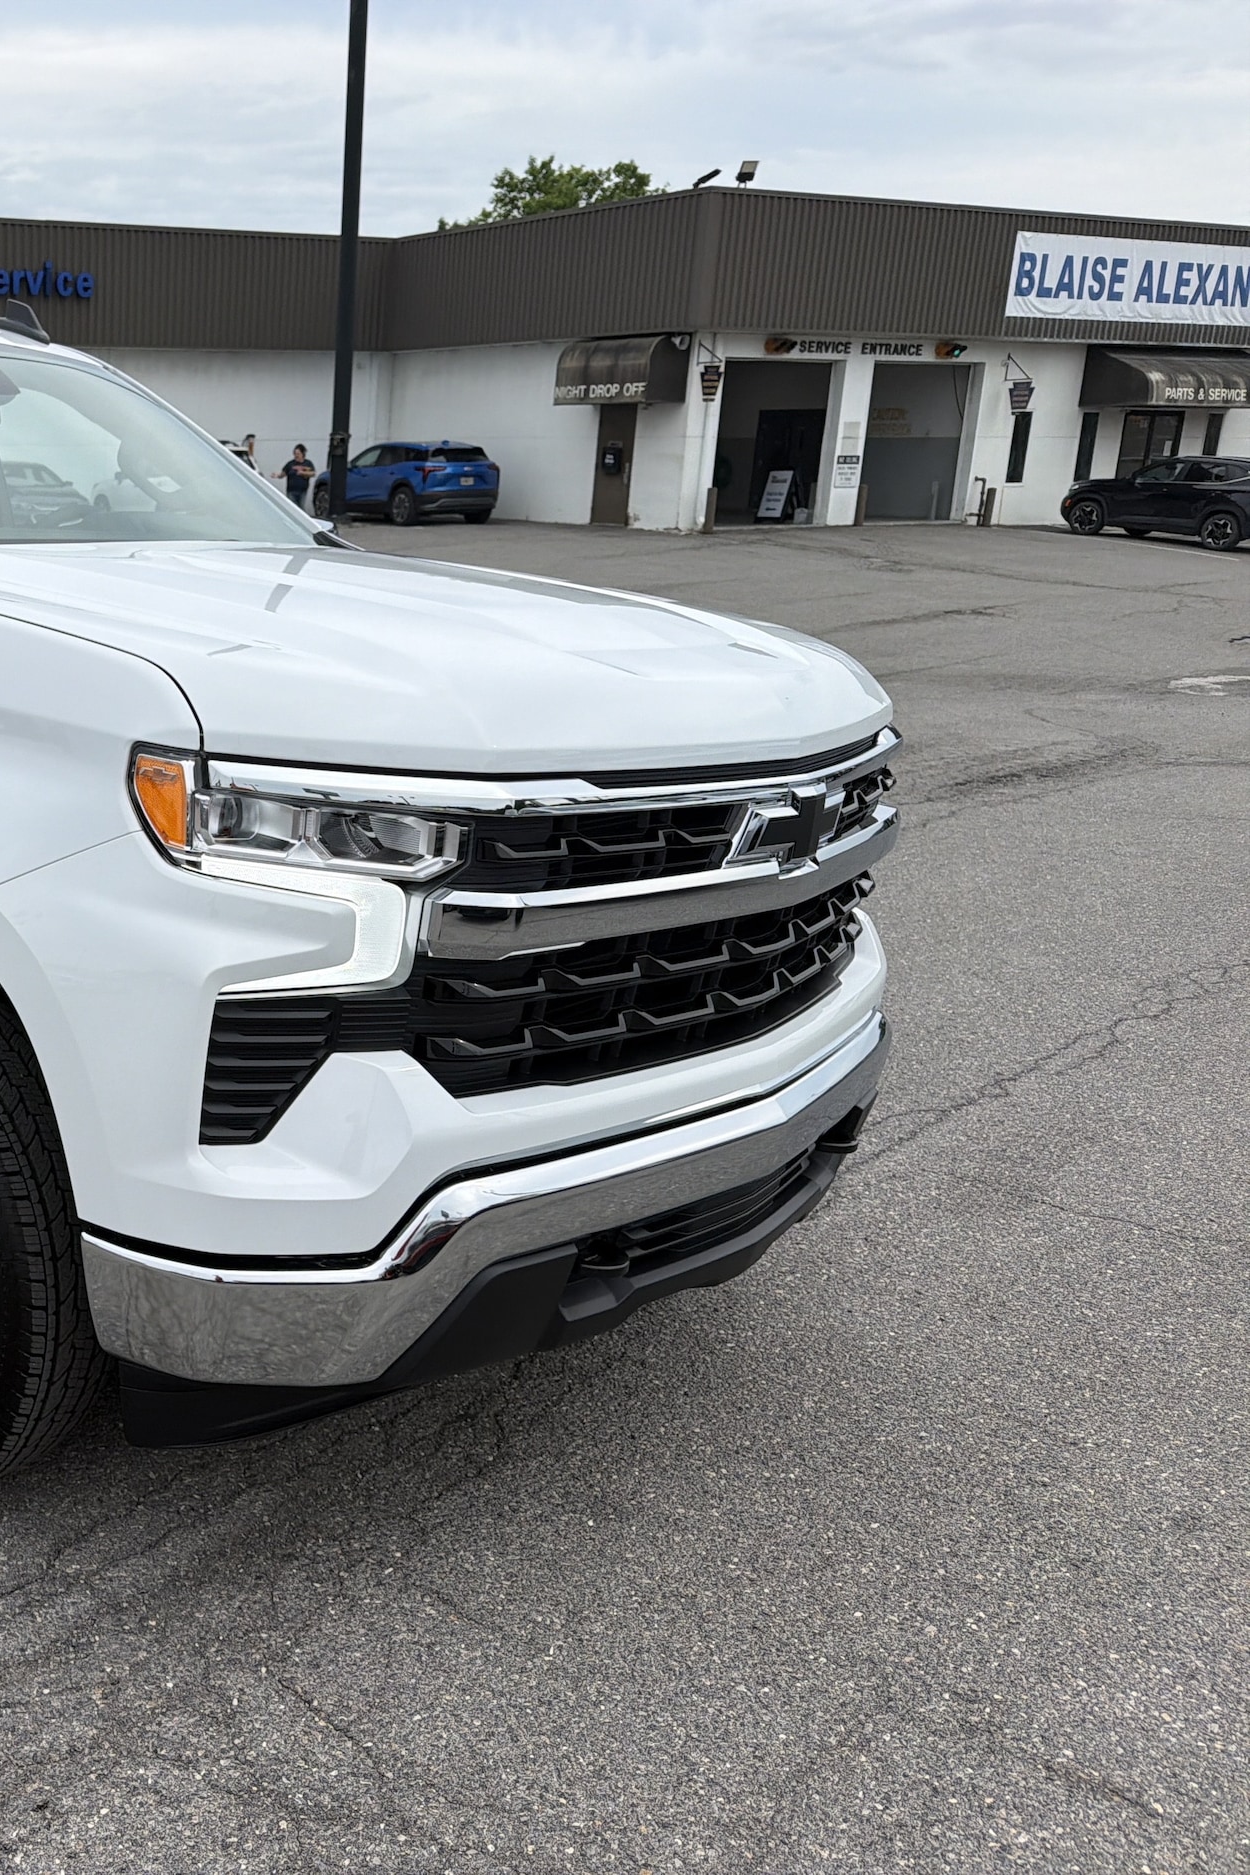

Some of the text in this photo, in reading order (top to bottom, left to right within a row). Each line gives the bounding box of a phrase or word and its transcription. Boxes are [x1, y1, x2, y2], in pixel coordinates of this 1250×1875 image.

[1014, 252, 1250, 308] BLAISE ALEXAN
[798, 340, 924, 356] SERVICE ENTRANCE
[554, 382, 648, 399] NIGHT DROP OFF
[1165, 387, 1247, 402] PARTS & SERVICE
